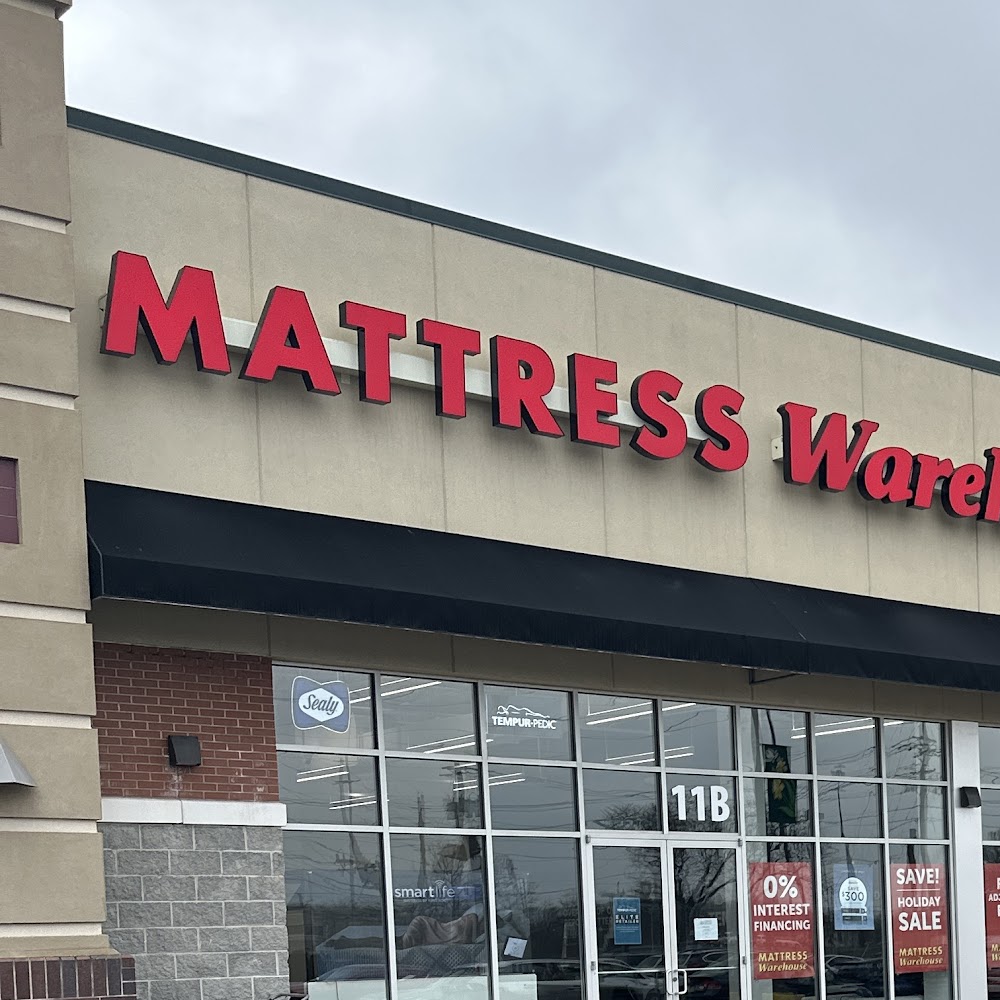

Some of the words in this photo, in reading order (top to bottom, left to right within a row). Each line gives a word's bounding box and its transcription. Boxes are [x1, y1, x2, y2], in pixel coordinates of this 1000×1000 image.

[100, 250, 749, 473] MATTRESS
[302, 693, 339, 715] Sealy
[671, 784, 730, 822] 11B
[896, 868, 939, 885] SAVE!
[394, 885, 456, 899] smartlife
[763, 875, 799, 899] 0%
[897, 896, 941, 908] HOLIDAY
[753, 903, 811, 917] INTEREST
[753, 919, 811, 932] FINANCING
[898, 911, 942, 932] SALE
[758, 951, 808, 963] MATTRESS
[899, 946, 943, 957] MATTRESS
[758, 962, 808, 972] Warehouse
[899, 957, 944, 966] Warehouse
